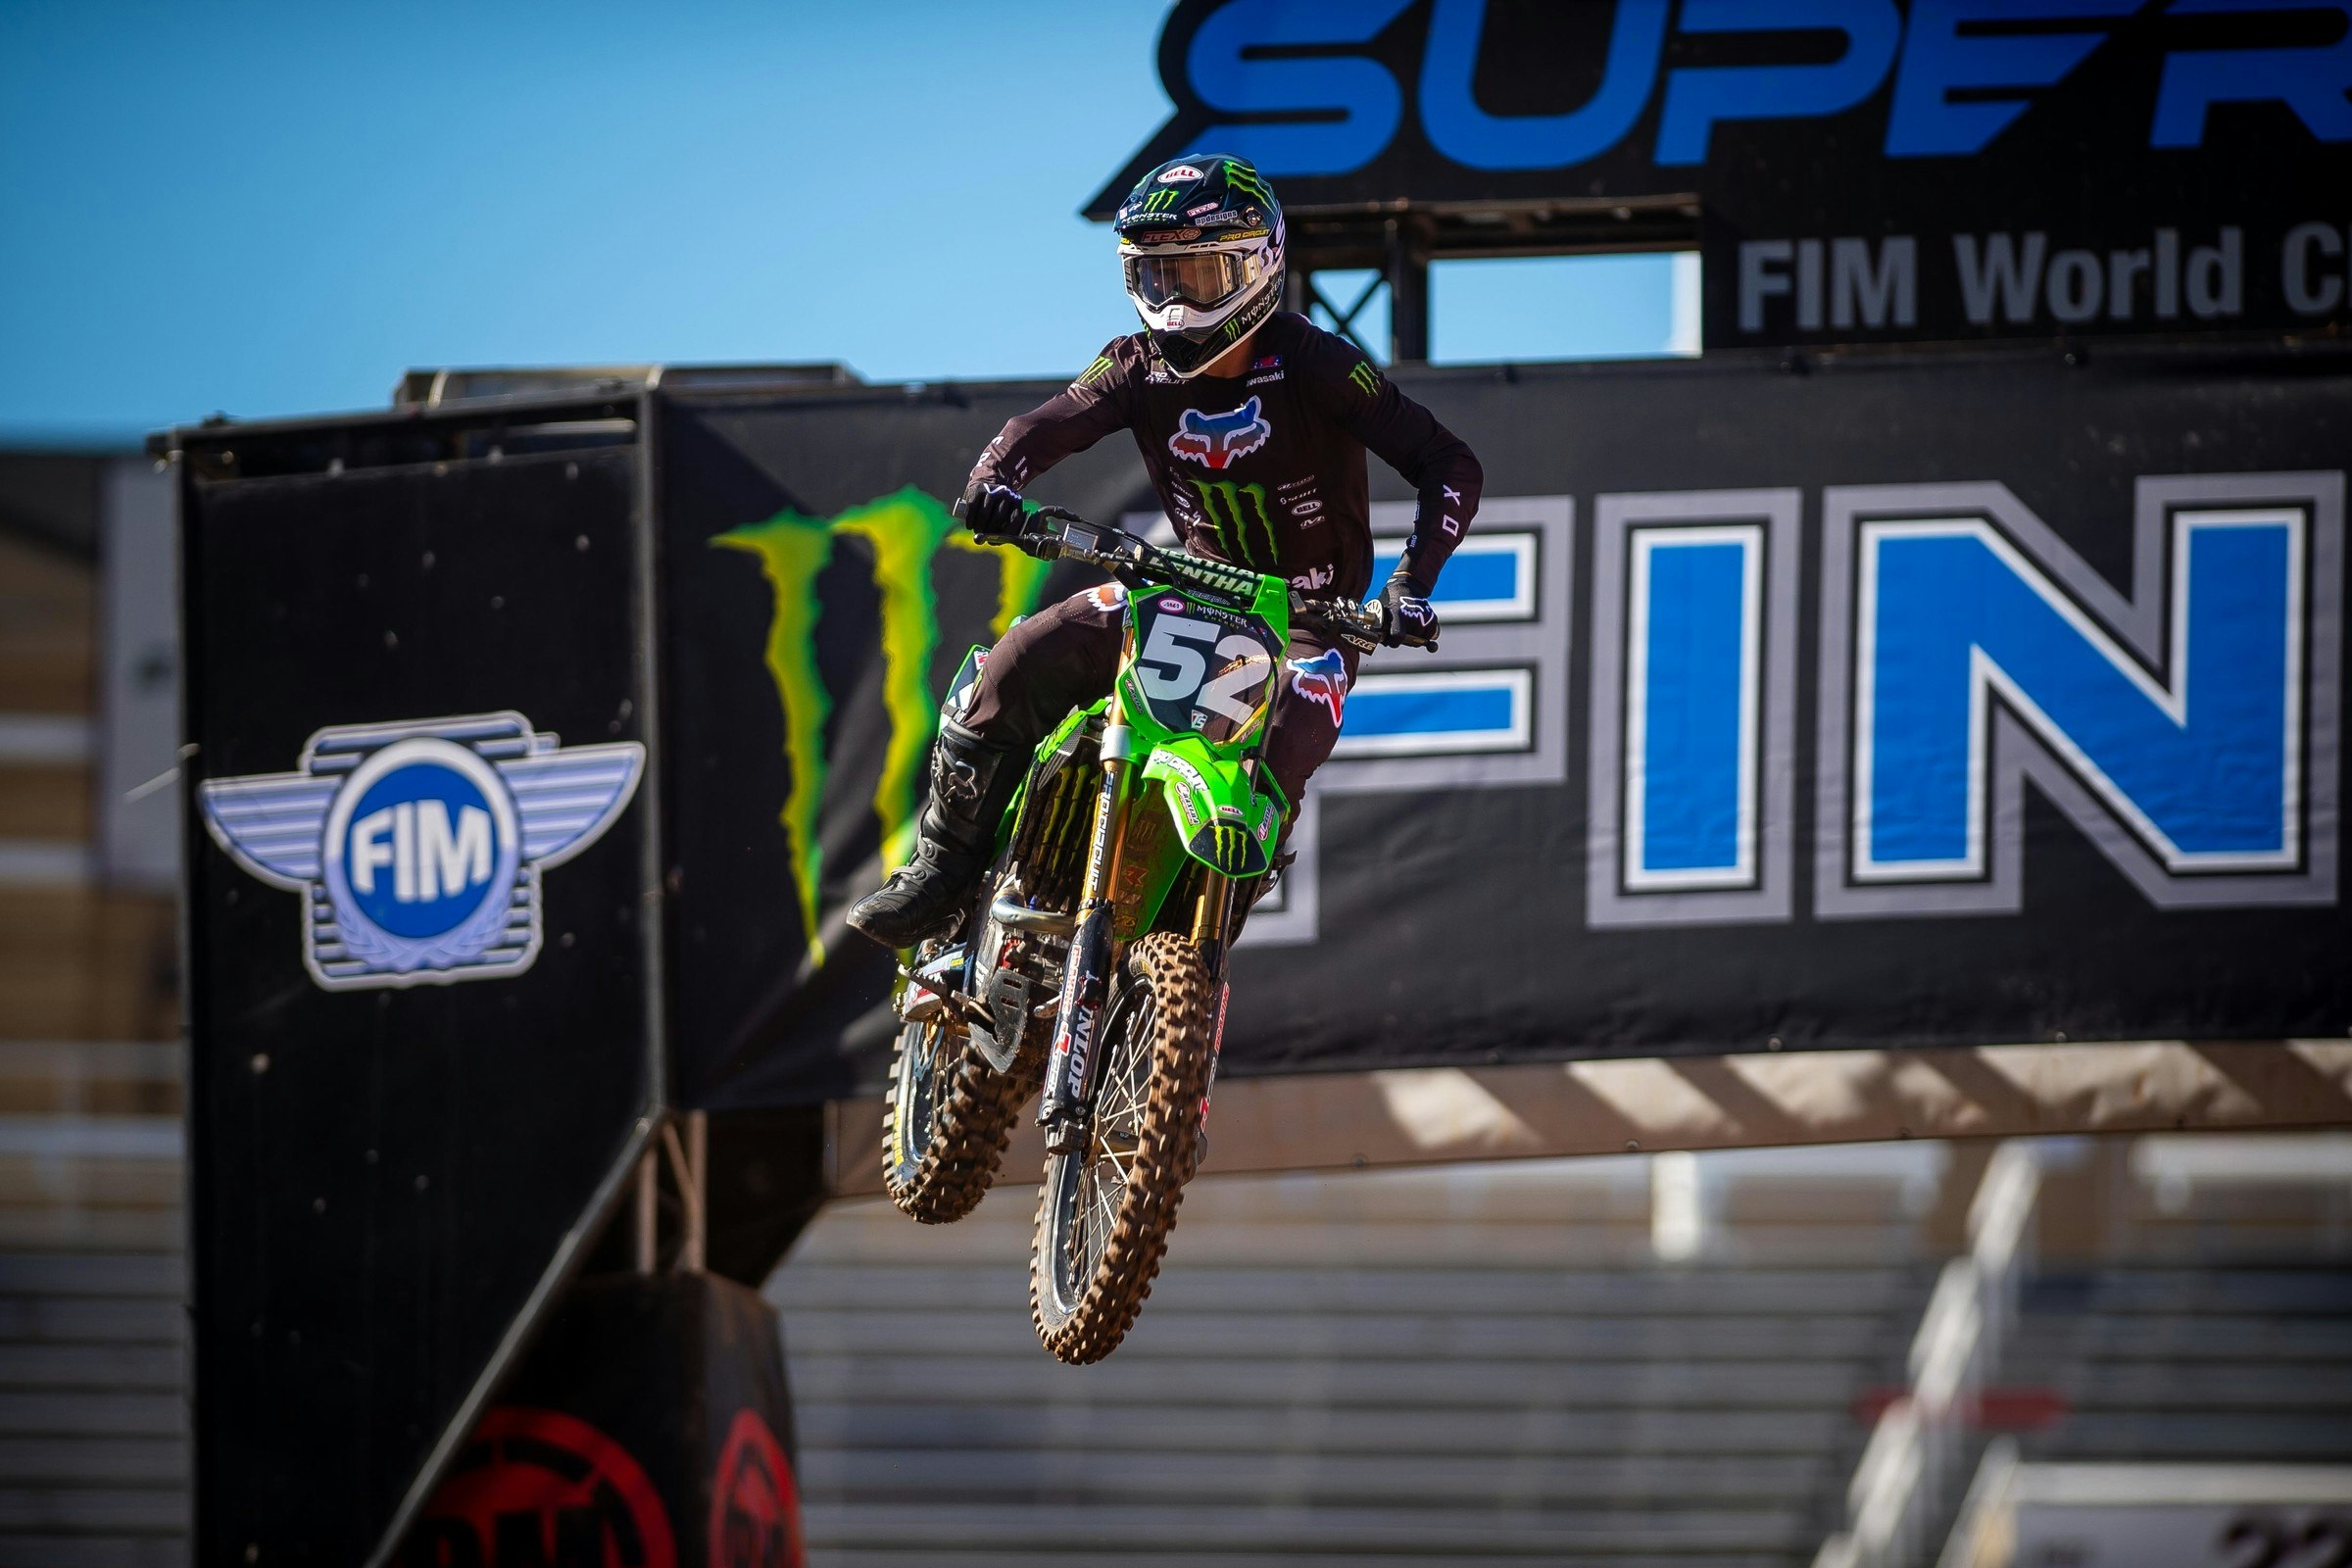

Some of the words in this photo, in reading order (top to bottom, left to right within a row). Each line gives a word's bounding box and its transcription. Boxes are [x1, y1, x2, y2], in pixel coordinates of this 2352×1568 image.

[1165, 170, 1195, 178] BELL
[1219, 233, 1241, 242] PRO
[1242, 228, 1271, 238] CIRCUIT
[1738, 234, 1917, 333] FIM
[1953, 225, 2243, 323] World
[1297, 503, 1318, 514] BELL
[1197, 605, 1248, 627] MONSTER
[1341, 633, 1377, 651] ARC
[1137, 612, 1271, 725] 52
[350, 799, 492, 903] FIM
[1068, 970, 1100, 1099] NLOP
